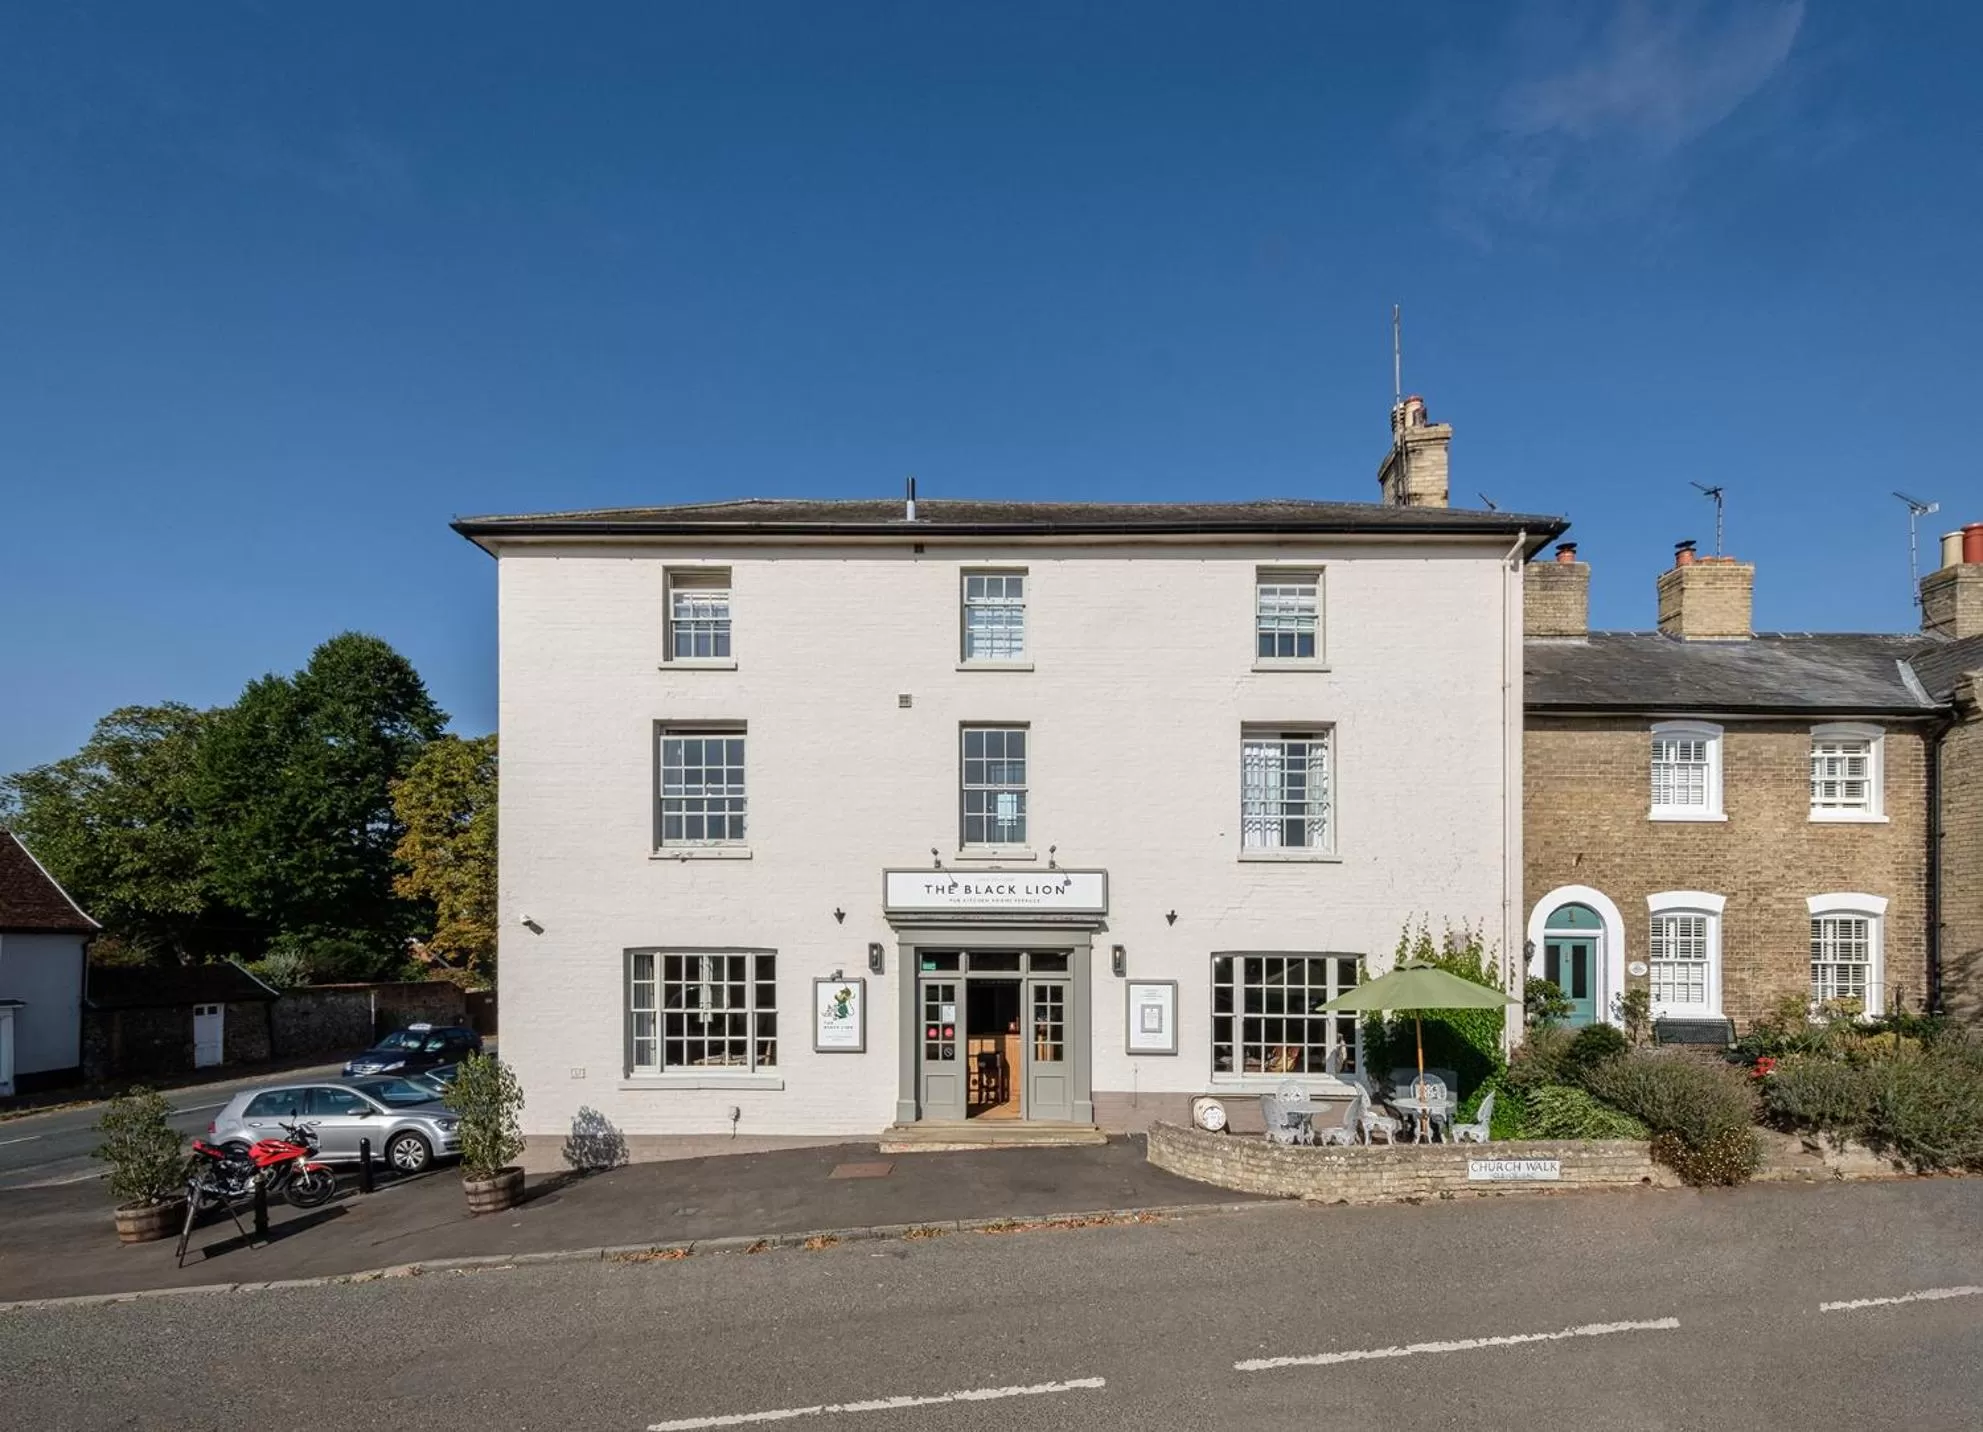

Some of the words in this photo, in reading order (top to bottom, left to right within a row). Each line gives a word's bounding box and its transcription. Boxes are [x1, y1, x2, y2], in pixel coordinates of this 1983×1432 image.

[924, 884, 956, 895] THE
[964, 884, 1017, 895] BLACK
[1025, 884, 1066, 895] LION
[1471, 1162, 1521, 1172] CHURCH
[1526, 1162, 1557, 1172] WALK
